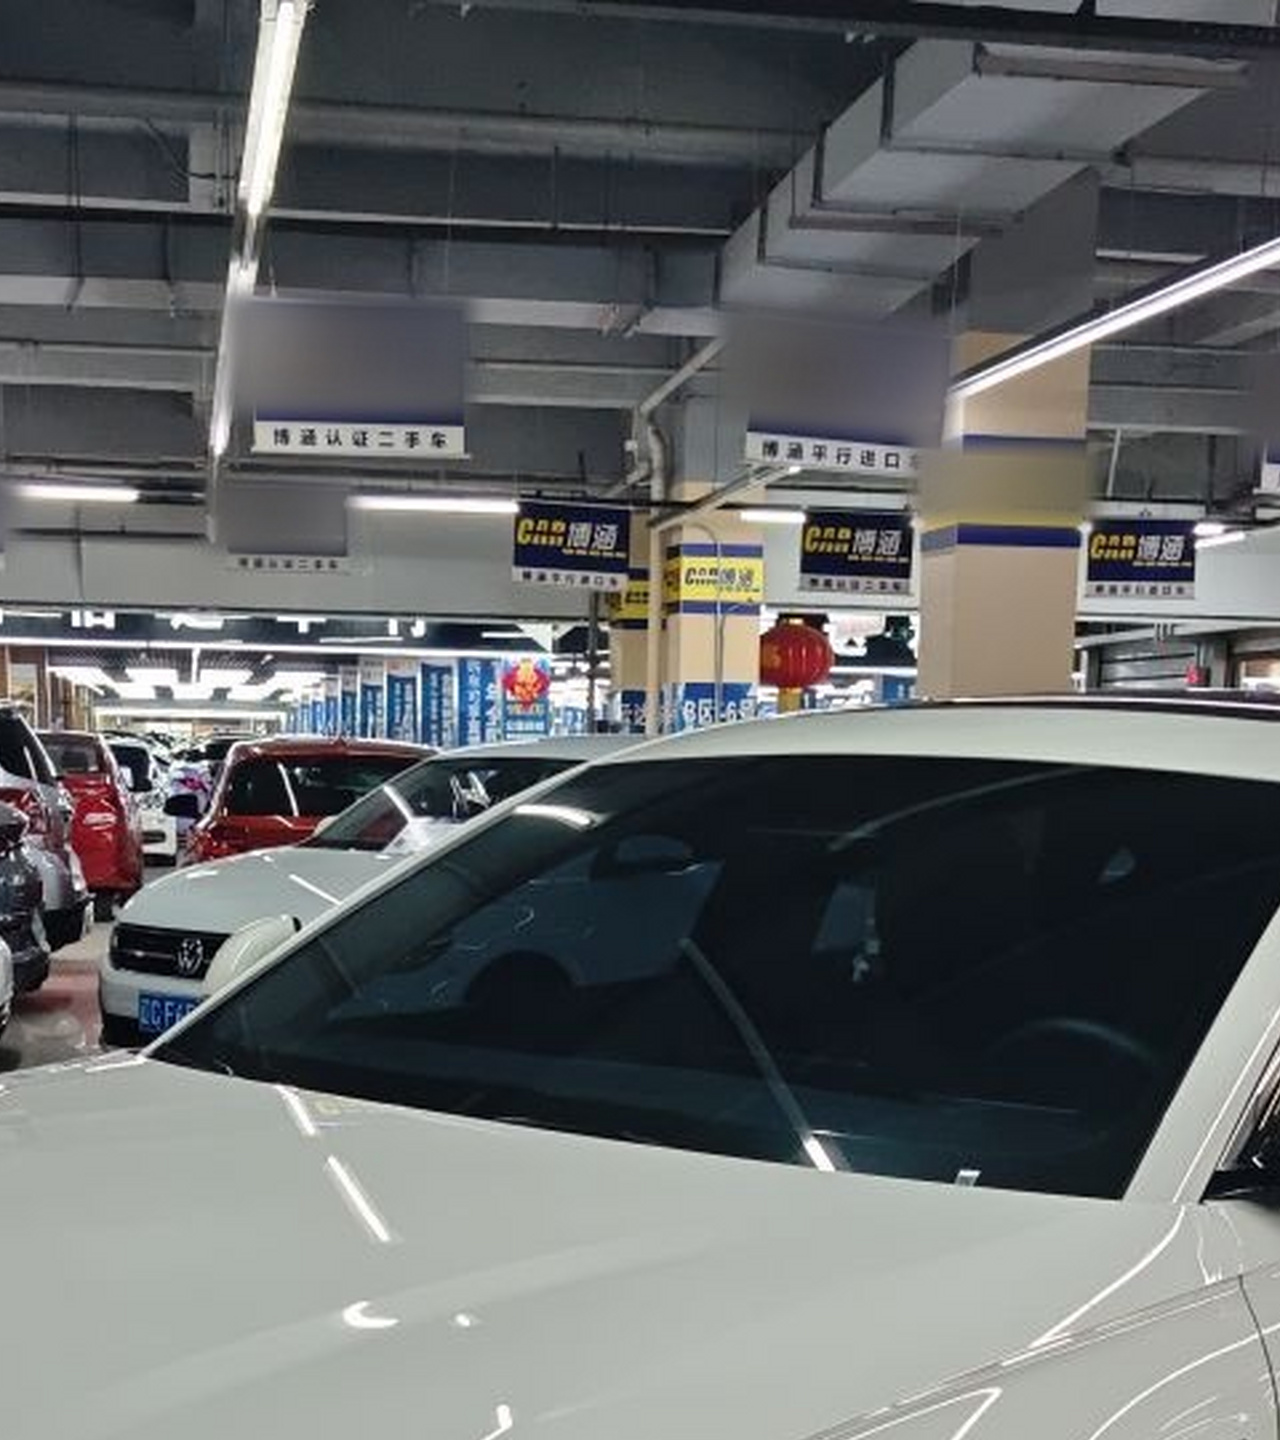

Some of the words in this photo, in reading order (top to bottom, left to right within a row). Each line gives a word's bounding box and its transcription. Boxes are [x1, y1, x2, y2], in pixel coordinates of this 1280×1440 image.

[273, 428, 447, 449] 博涵认证二手车
[517, 517, 567, 546] CAR
[804, 526, 853, 553] CAR
[1089, 533, 1137, 560] CAR
